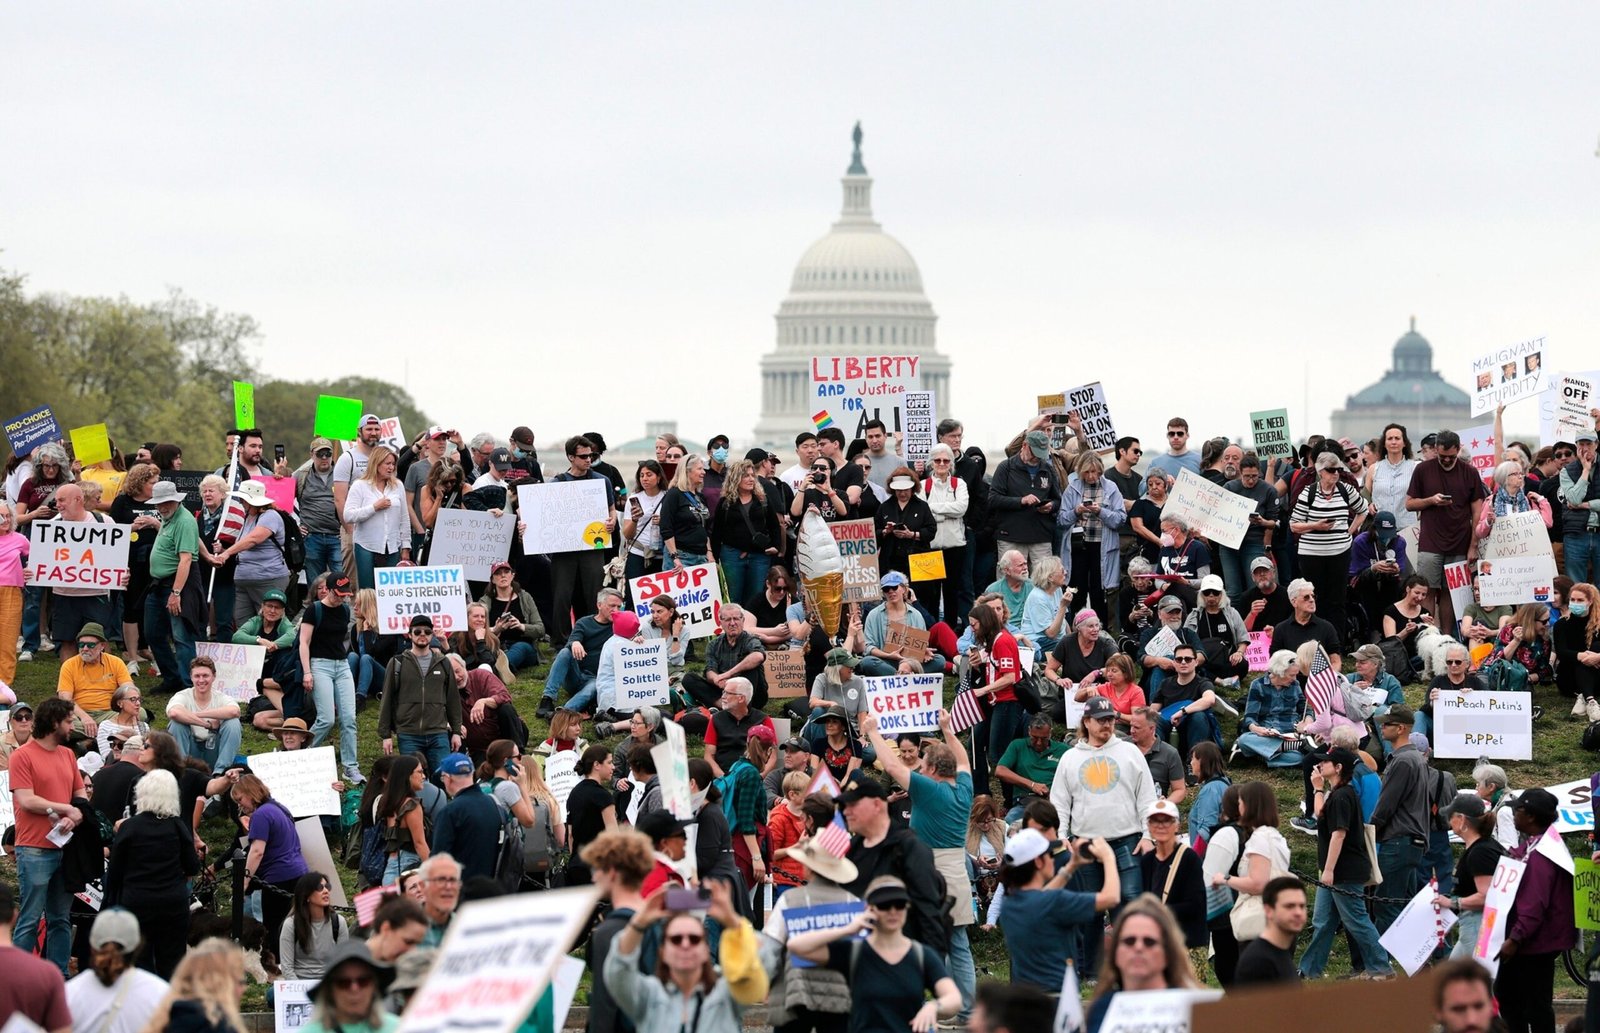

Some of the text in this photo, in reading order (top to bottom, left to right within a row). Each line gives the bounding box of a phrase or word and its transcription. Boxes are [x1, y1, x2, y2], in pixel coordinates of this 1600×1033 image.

[1473, 336, 1546, 372] MALIGNANT
[813, 356, 919, 382] LIBERTY
[858, 381, 905, 396] Justice
[1476, 371, 1541, 409] STUPIDITY
[1564, 377, 1590, 389] HANDS
[1070, 387, 1094, 407] STOP
[1564, 386, 1589, 400] OFF
[906, 400, 930, 409] OFF!
[5, 408, 52, 433] PRO-CHOICE
[907, 423, 930, 432] OFF!
[1096, 415, 1113, 432] ON
[1253, 416, 1285, 430] WE NEED
[1255, 430, 1286, 444] FEDERAL
[1256, 442, 1289, 457] WORKERS
[1195, 490, 1220, 508] FREE
[444, 519, 505, 531] WHEN YOU PLAY
[830, 523, 874, 541] ERYONE
[36, 523, 123, 546] TRUMP
[446, 530, 507, 543] STUPID GAMES
[461, 543, 496, 553] YOU WIN
[837, 539, 876, 556] ERVES
[54, 548, 94, 566] IS A
[446, 553, 475, 565] STUPID
[35, 564, 125, 586] FASCIST
[843, 566, 877, 585] CESS
[378, 585, 462, 598] IS OUR STRENGTH
[636, 568, 708, 600] STOP
[395, 602, 441, 615] STAND
[387, 614, 453, 631] UNED
[891, 632, 926, 651] RESIST
[635, 645, 661, 655] many
[768, 652, 791, 662] Stop
[636, 673, 662, 684] little
[866, 676, 942, 692] IS THIS WHAT
[873, 690, 934, 713] GREAT
[1489, 698, 1522, 711] Putin's
